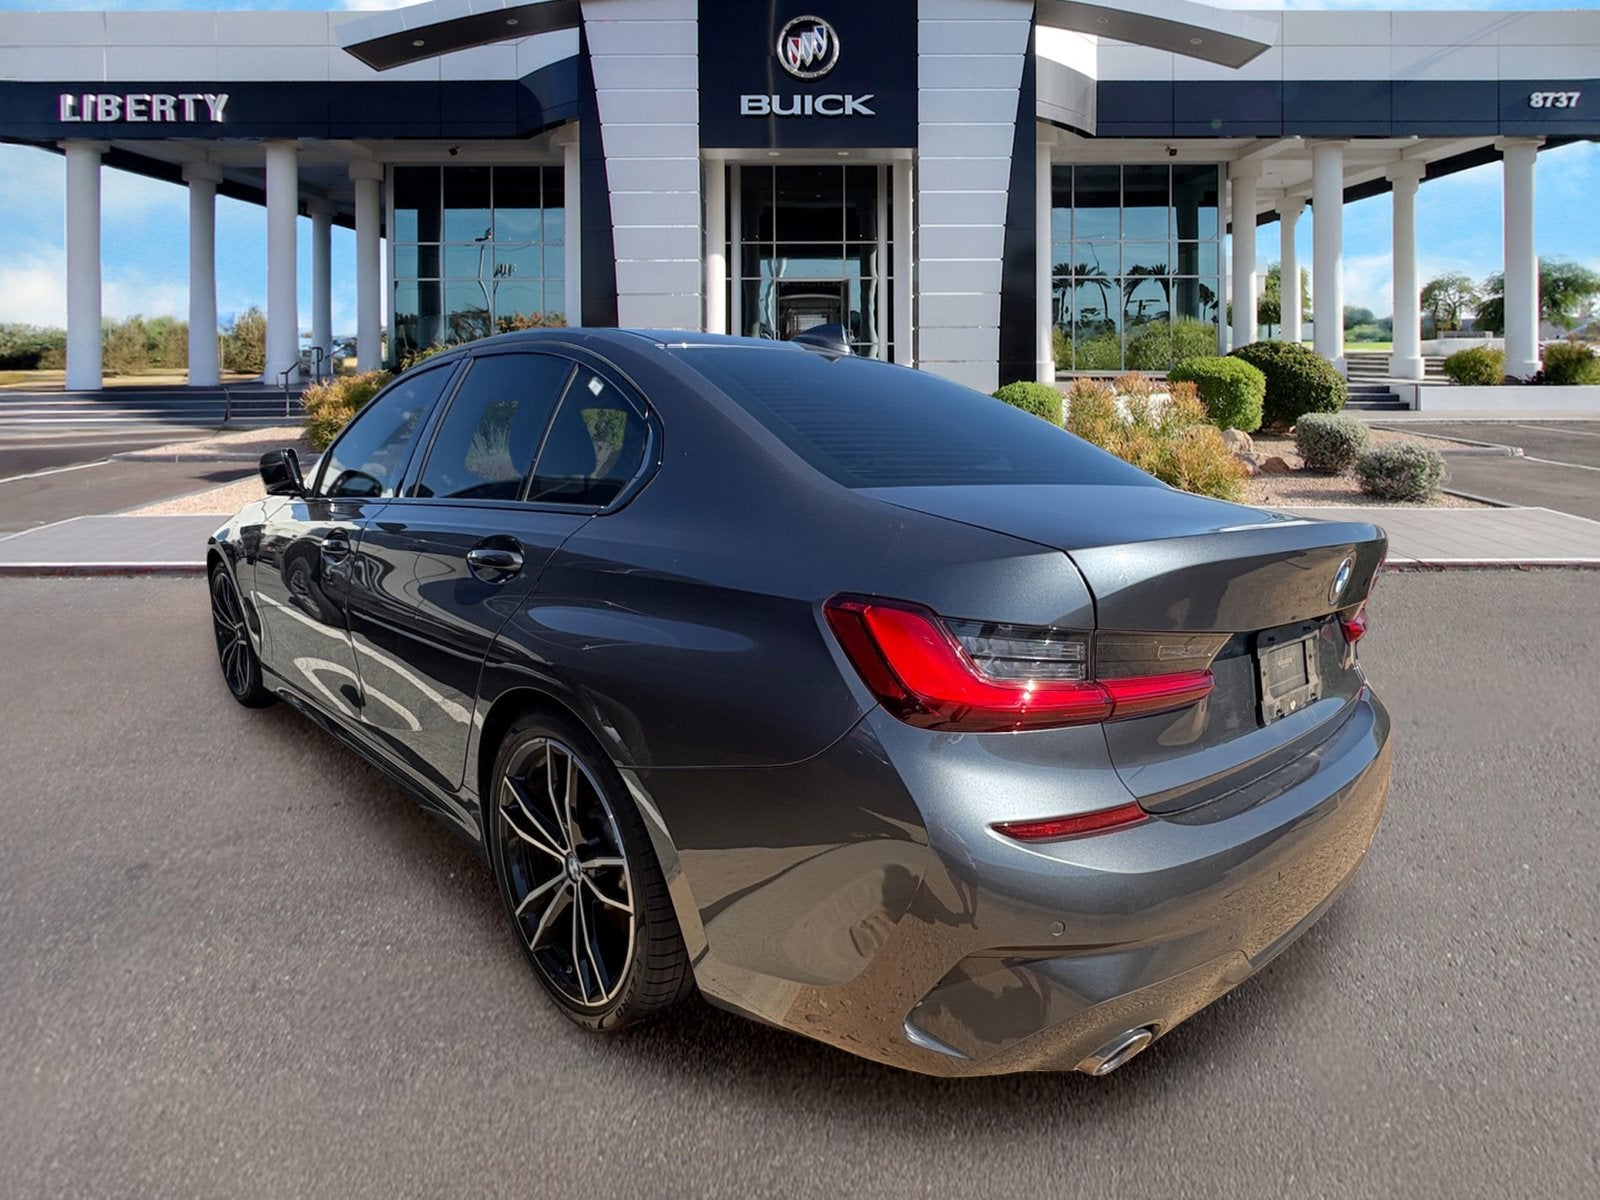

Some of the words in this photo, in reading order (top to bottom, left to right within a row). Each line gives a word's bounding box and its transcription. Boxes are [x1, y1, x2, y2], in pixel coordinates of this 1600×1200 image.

[59, 93, 229, 122] LIBERTY
[740, 94, 876, 115] BUICK
[1529, 91, 1581, 108] 8737
